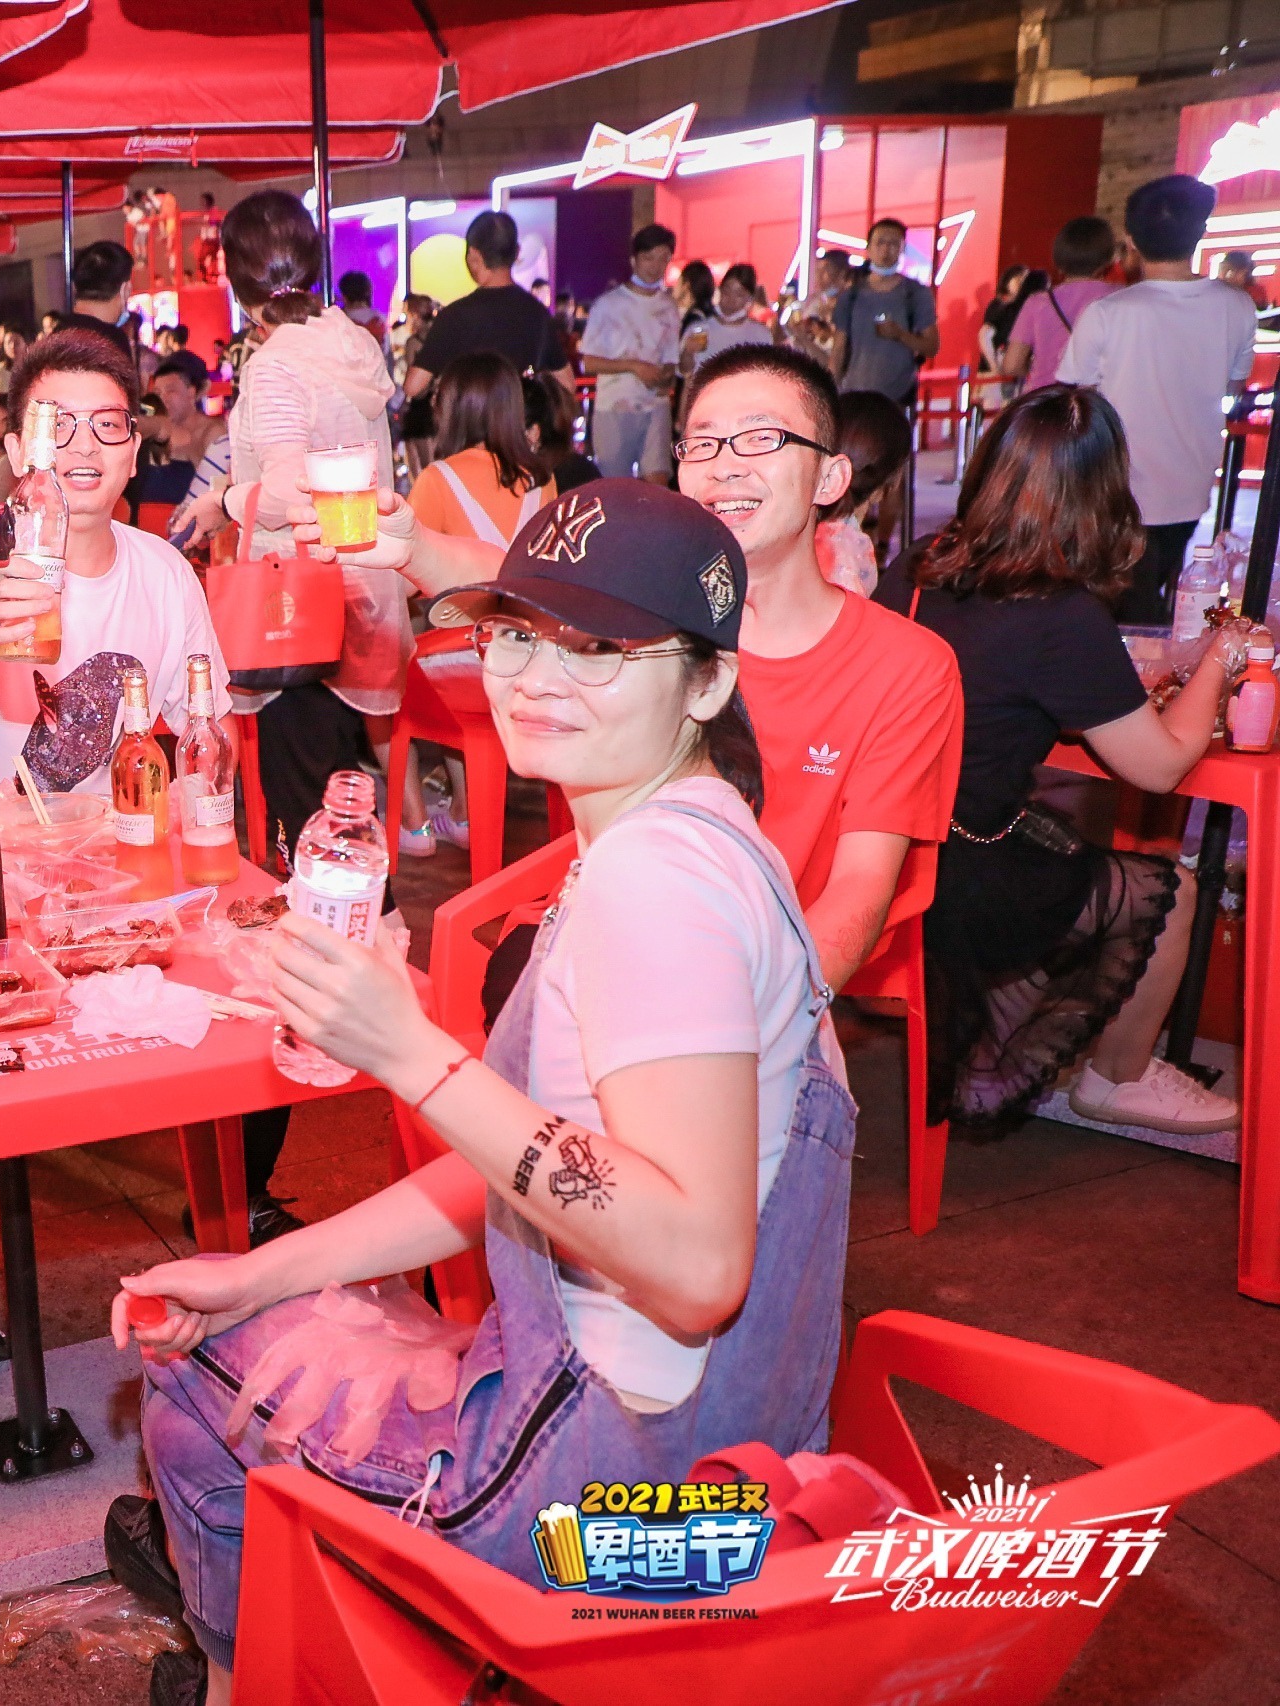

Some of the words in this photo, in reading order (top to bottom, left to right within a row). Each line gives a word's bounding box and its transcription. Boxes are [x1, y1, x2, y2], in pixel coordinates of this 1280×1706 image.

[802, 764, 836, 776] adidas
[20, 1052, 78, 1072] OUR
[77, 1044, 135, 1061] TRUE
[139, 1036, 172, 1050] SE
[513, 1146, 542, 1197] BEER
